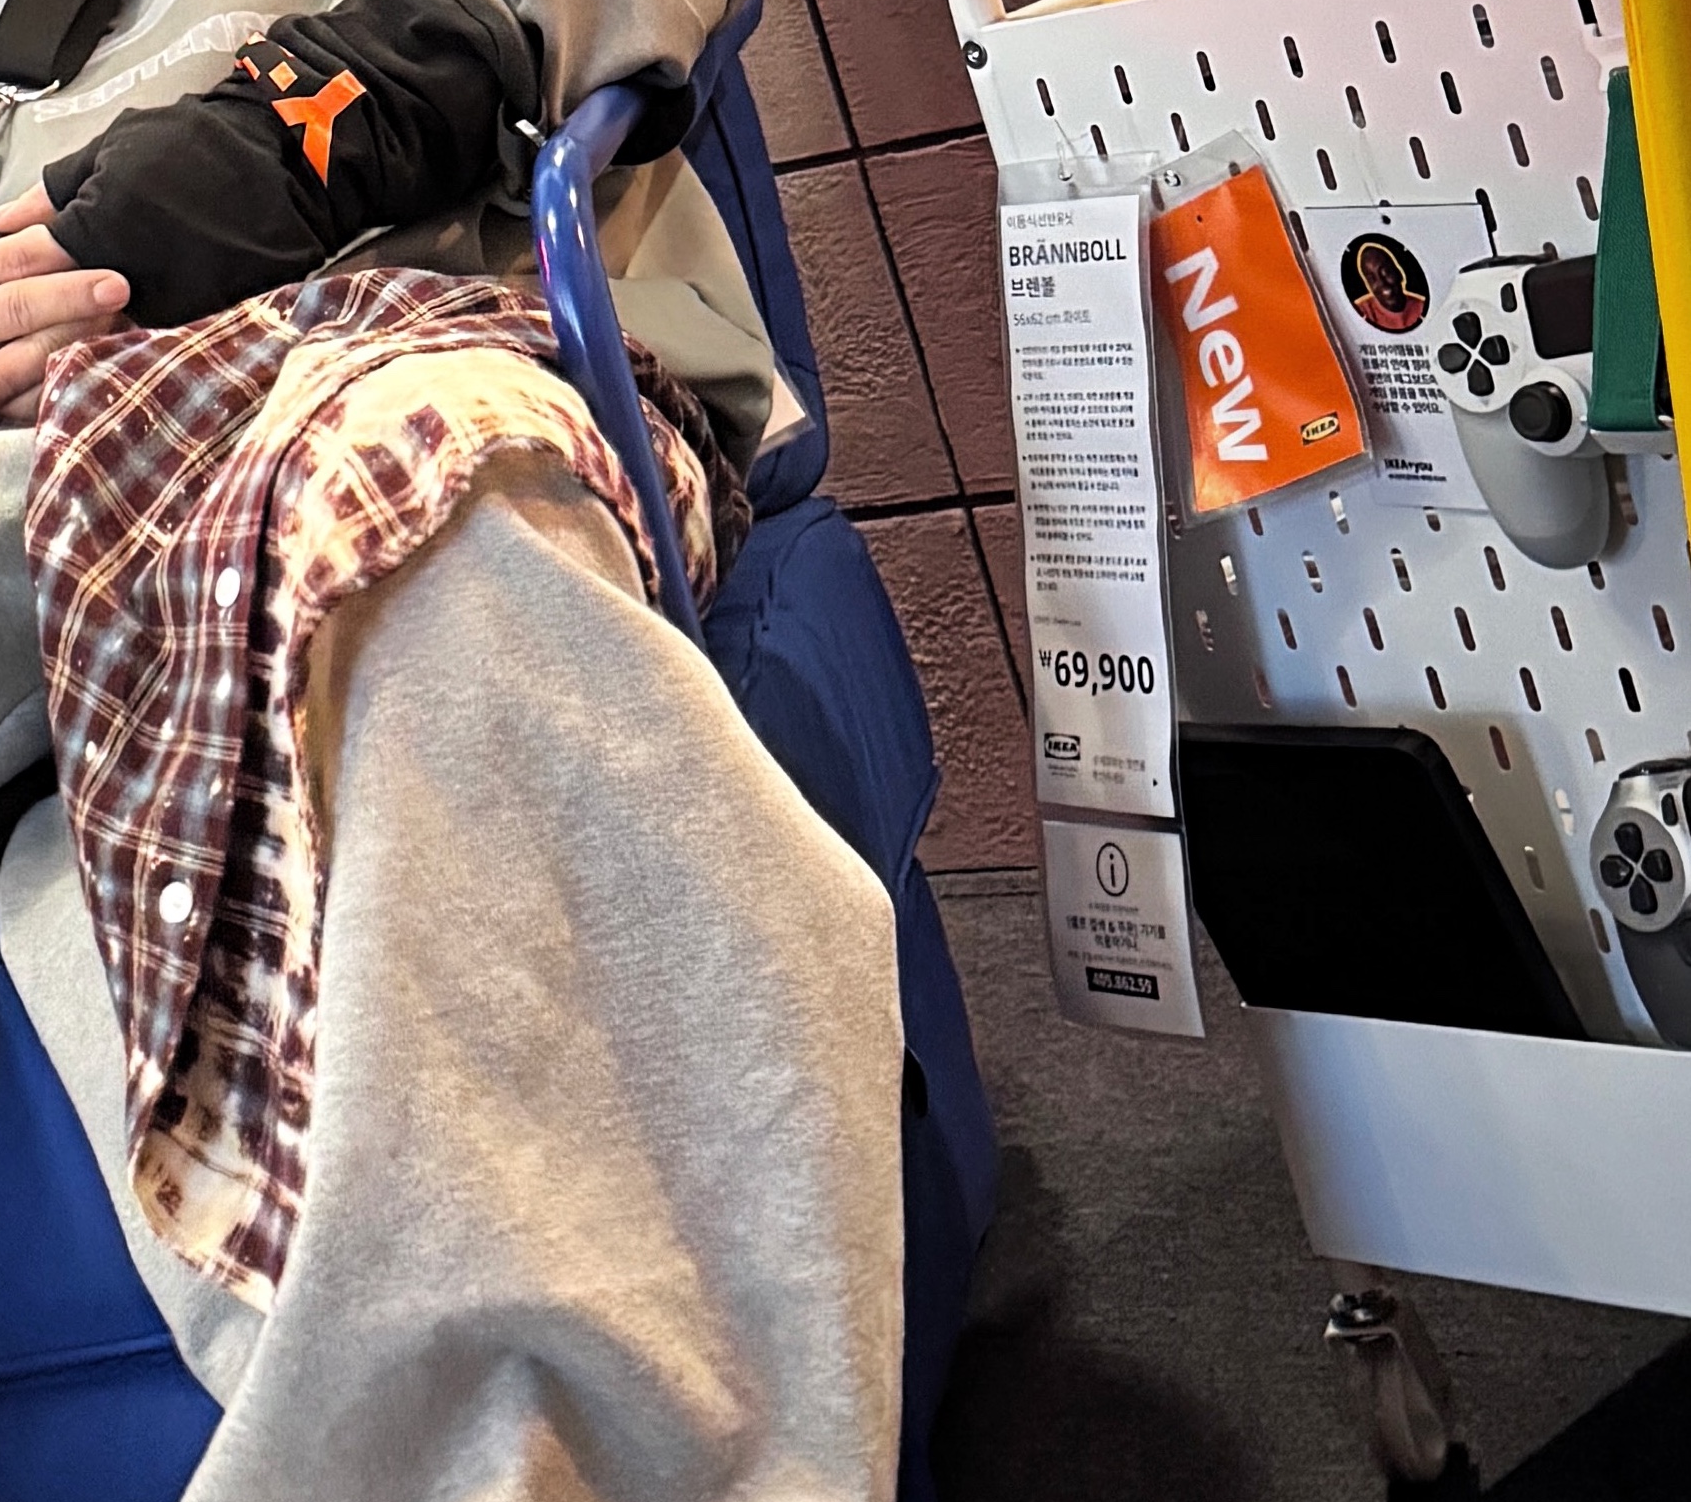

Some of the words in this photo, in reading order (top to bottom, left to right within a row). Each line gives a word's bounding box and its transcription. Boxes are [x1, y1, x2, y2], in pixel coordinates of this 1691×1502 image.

[1008, 238, 1127, 267] BRÄNNBOLL
[1164, 246, 1270, 462] New
[1038, 648, 1155, 697] ₩69,900
